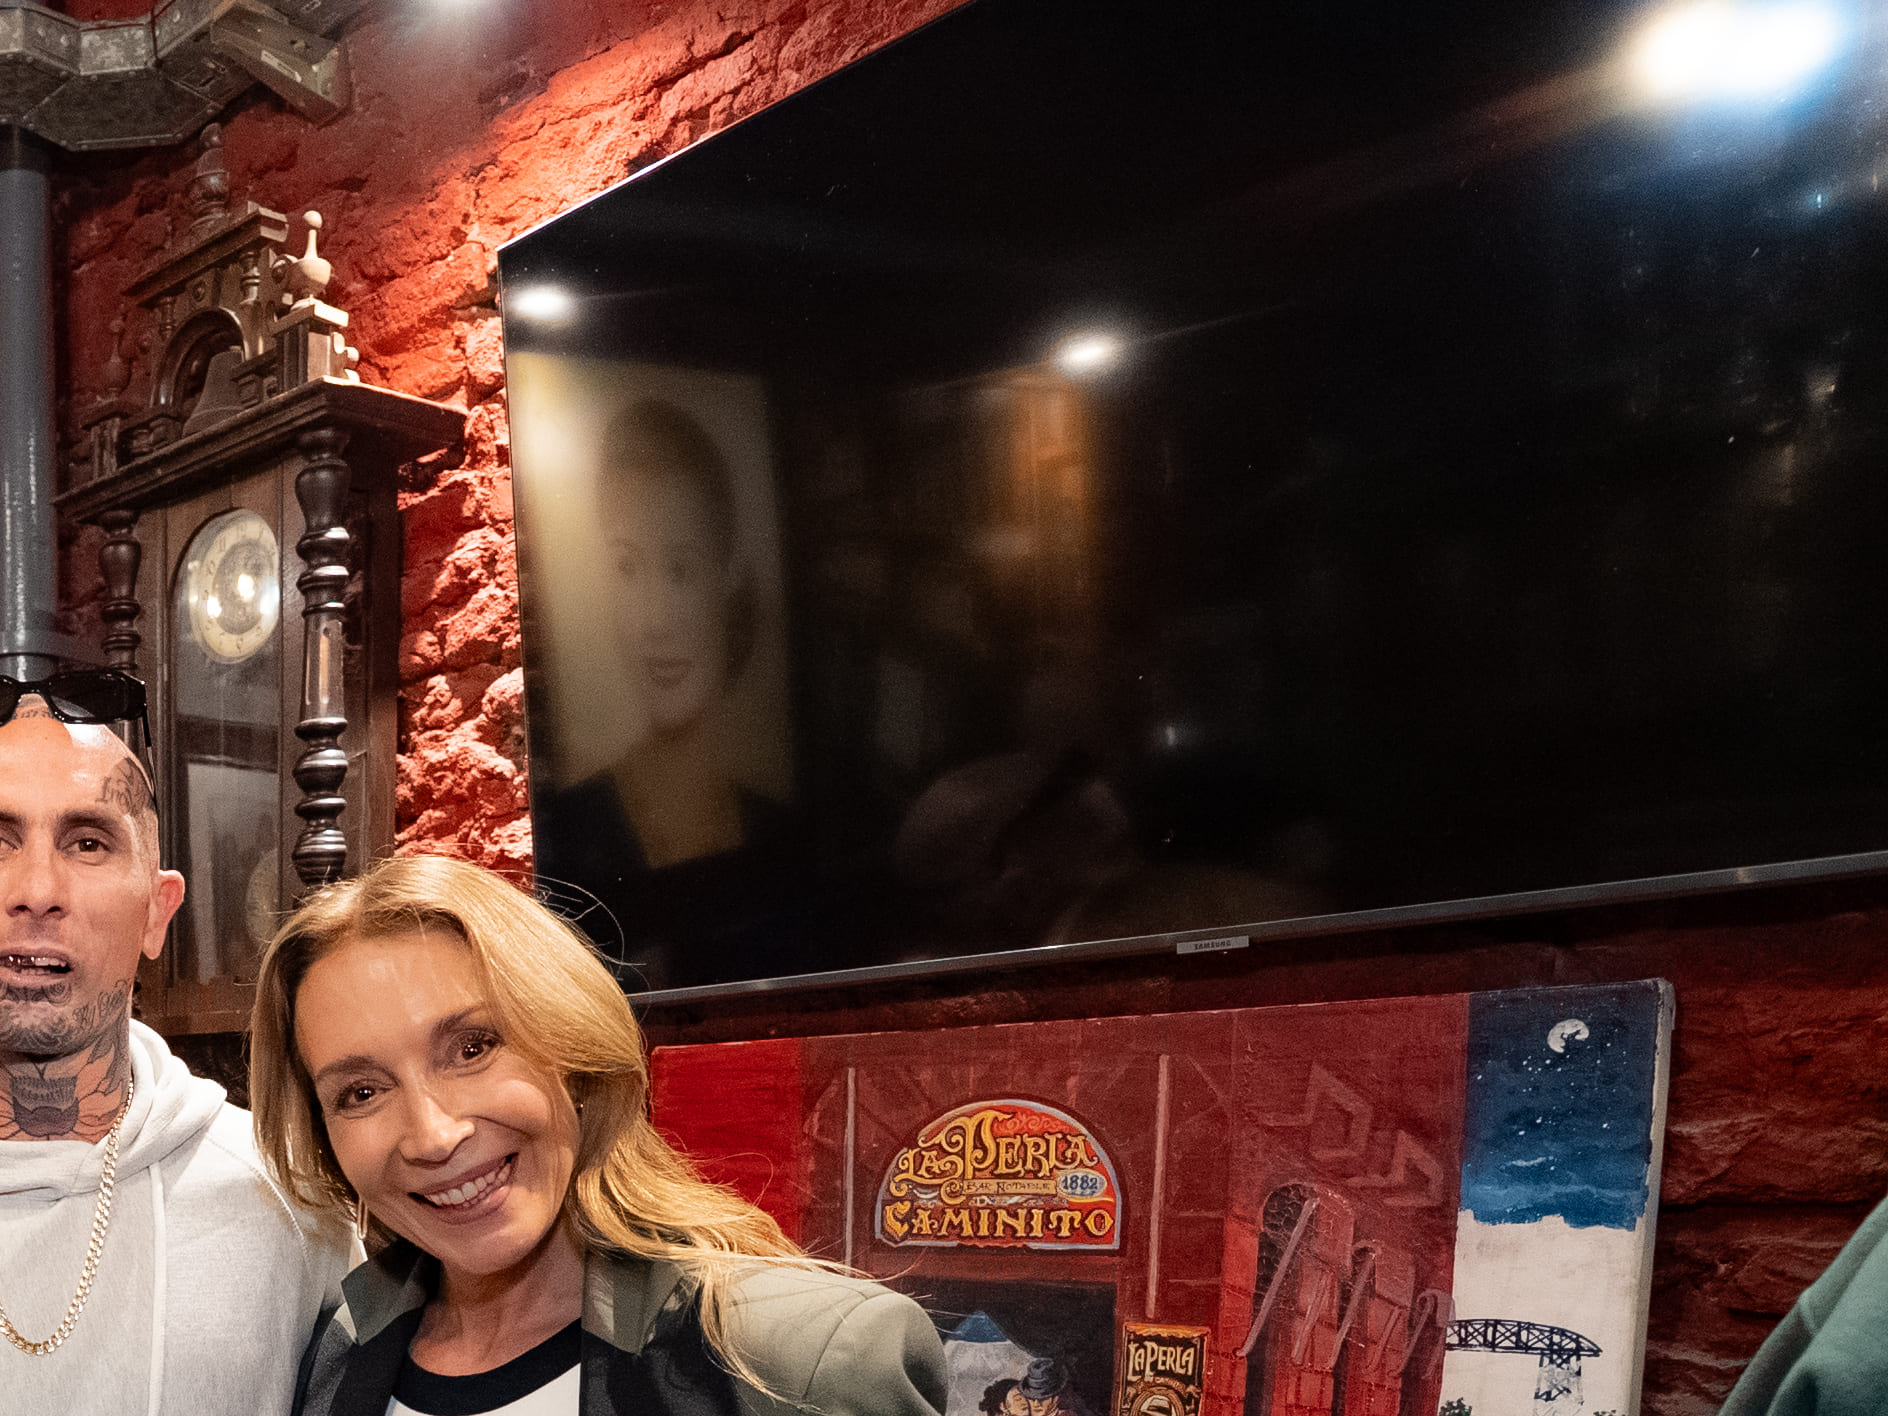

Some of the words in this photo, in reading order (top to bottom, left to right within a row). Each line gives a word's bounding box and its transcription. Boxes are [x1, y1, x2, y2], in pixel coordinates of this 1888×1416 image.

[1061, 1174, 1098, 1190] 1882
[884, 1200, 1114, 1239] CAMINITO
[1127, 1341, 1145, 1382] LA
[1143, 1340, 1195, 1382] PERLA
